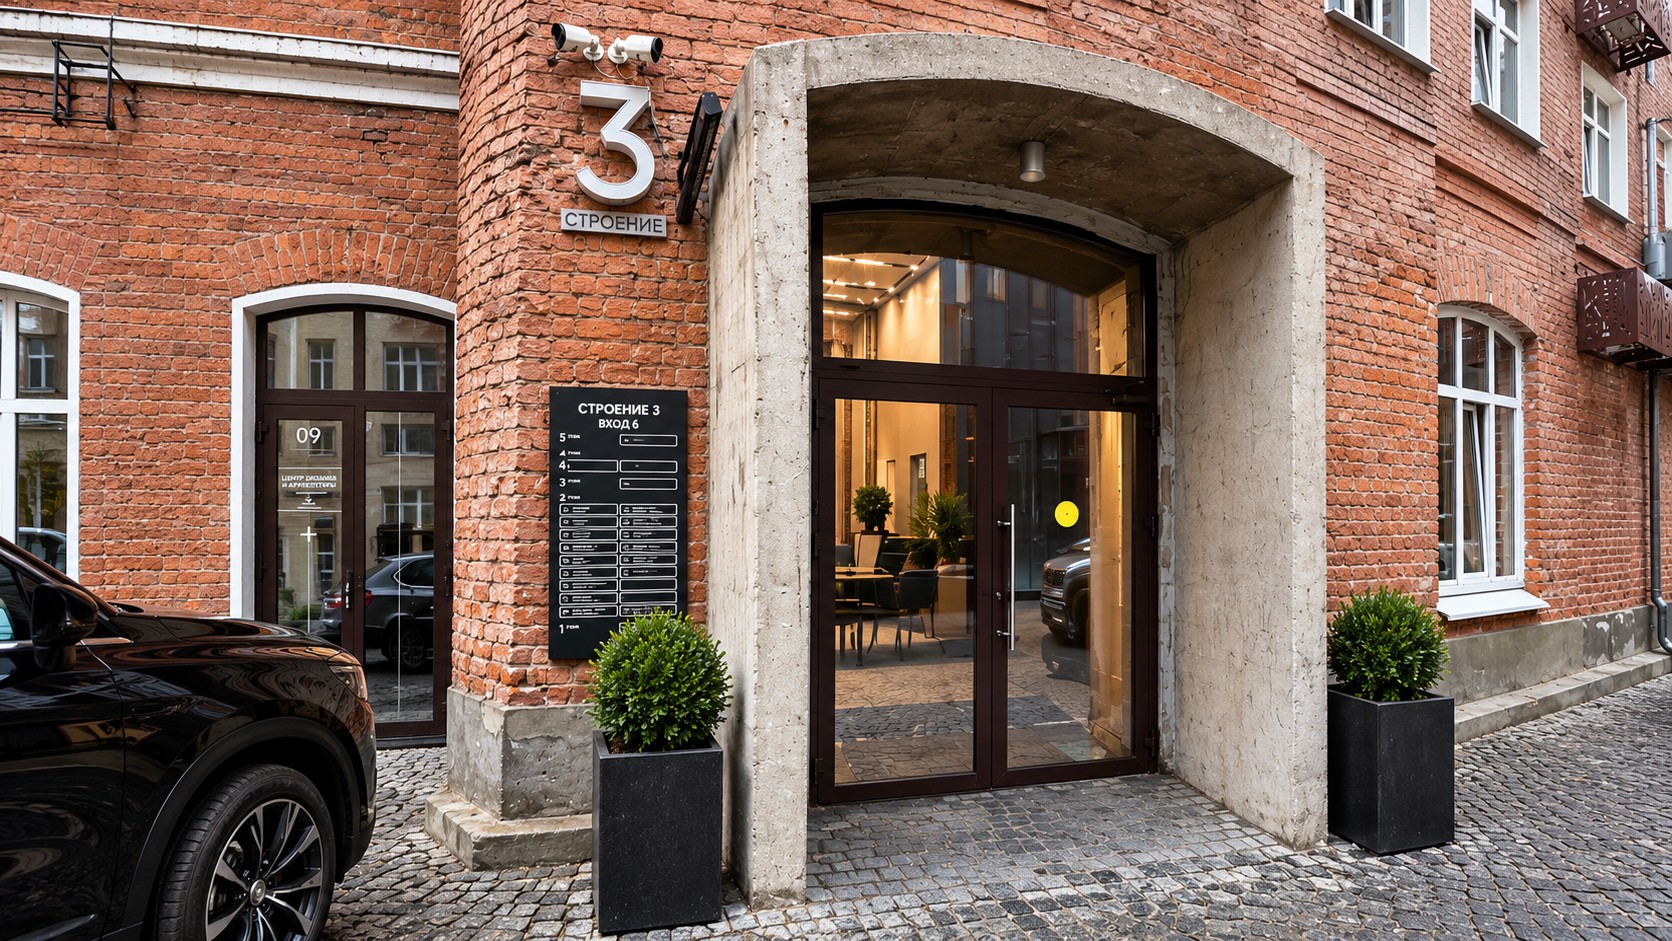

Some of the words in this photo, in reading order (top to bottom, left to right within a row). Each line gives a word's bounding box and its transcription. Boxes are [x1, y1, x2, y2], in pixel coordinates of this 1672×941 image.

[575, 80, 655, 206] 3
[565, 212, 663, 233] СТРОЕНИЕ
[578, 403, 649, 415] СТРОЕНИЕ
[652, 405, 660, 416] 3
[598, 419, 630, 430] ВХОД
[632, 420, 639, 429] 6
[296, 427, 321, 444] 09
[559, 433, 566, 442] 5
[558, 460, 566, 470] 4
[559, 478, 566, 487] 3
[559, 494, 566, 502] 2
[559, 624, 564, 634] 1
